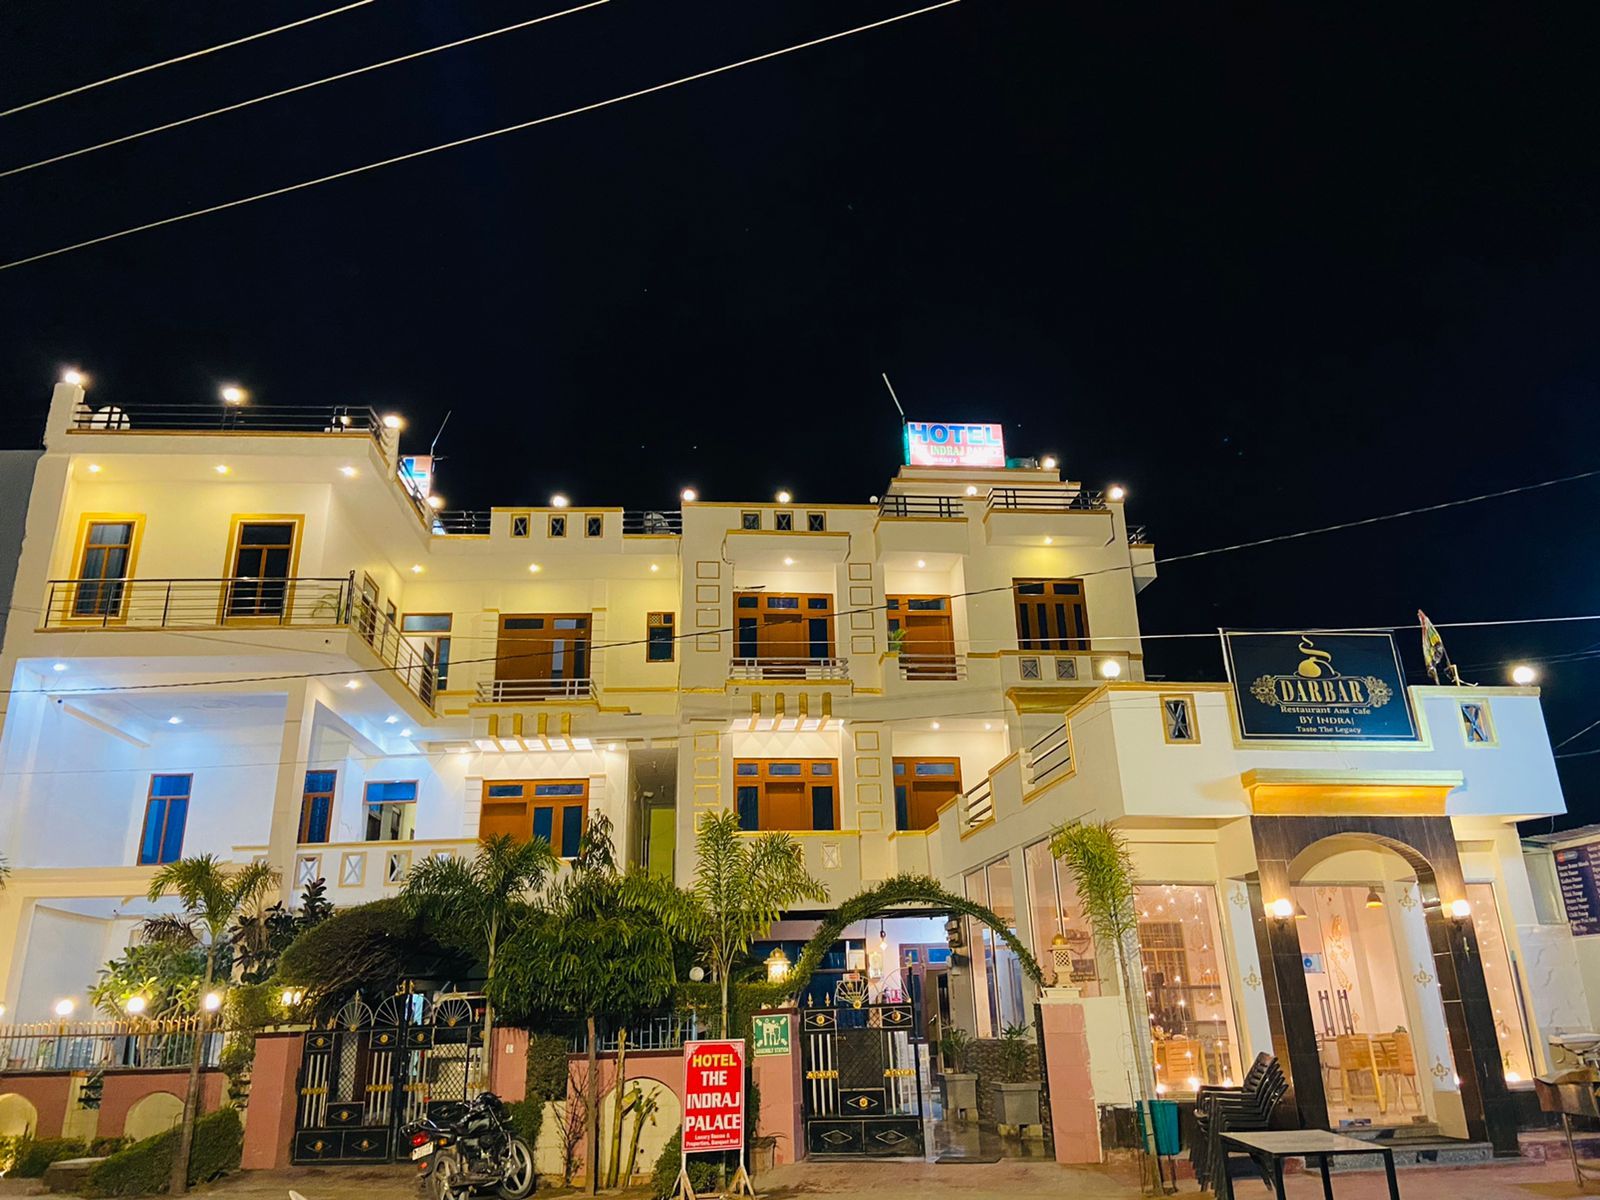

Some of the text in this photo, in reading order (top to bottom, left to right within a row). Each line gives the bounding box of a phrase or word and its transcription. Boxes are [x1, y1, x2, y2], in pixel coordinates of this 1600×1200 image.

[909, 423, 1001, 446] HOTEL
[1280, 679, 1364, 703] DARBAR
[1280, 705, 1330, 714] Restaurant
[1299, 716, 1314, 724] BY
[1335, 726, 1361, 734] Legacy
[692, 1053, 737, 1068] HOTEL
[700, 1070, 728, 1087] THE
[686, 1091, 741, 1110] INDRAJ
[685, 1113, 741, 1132] PALACE
